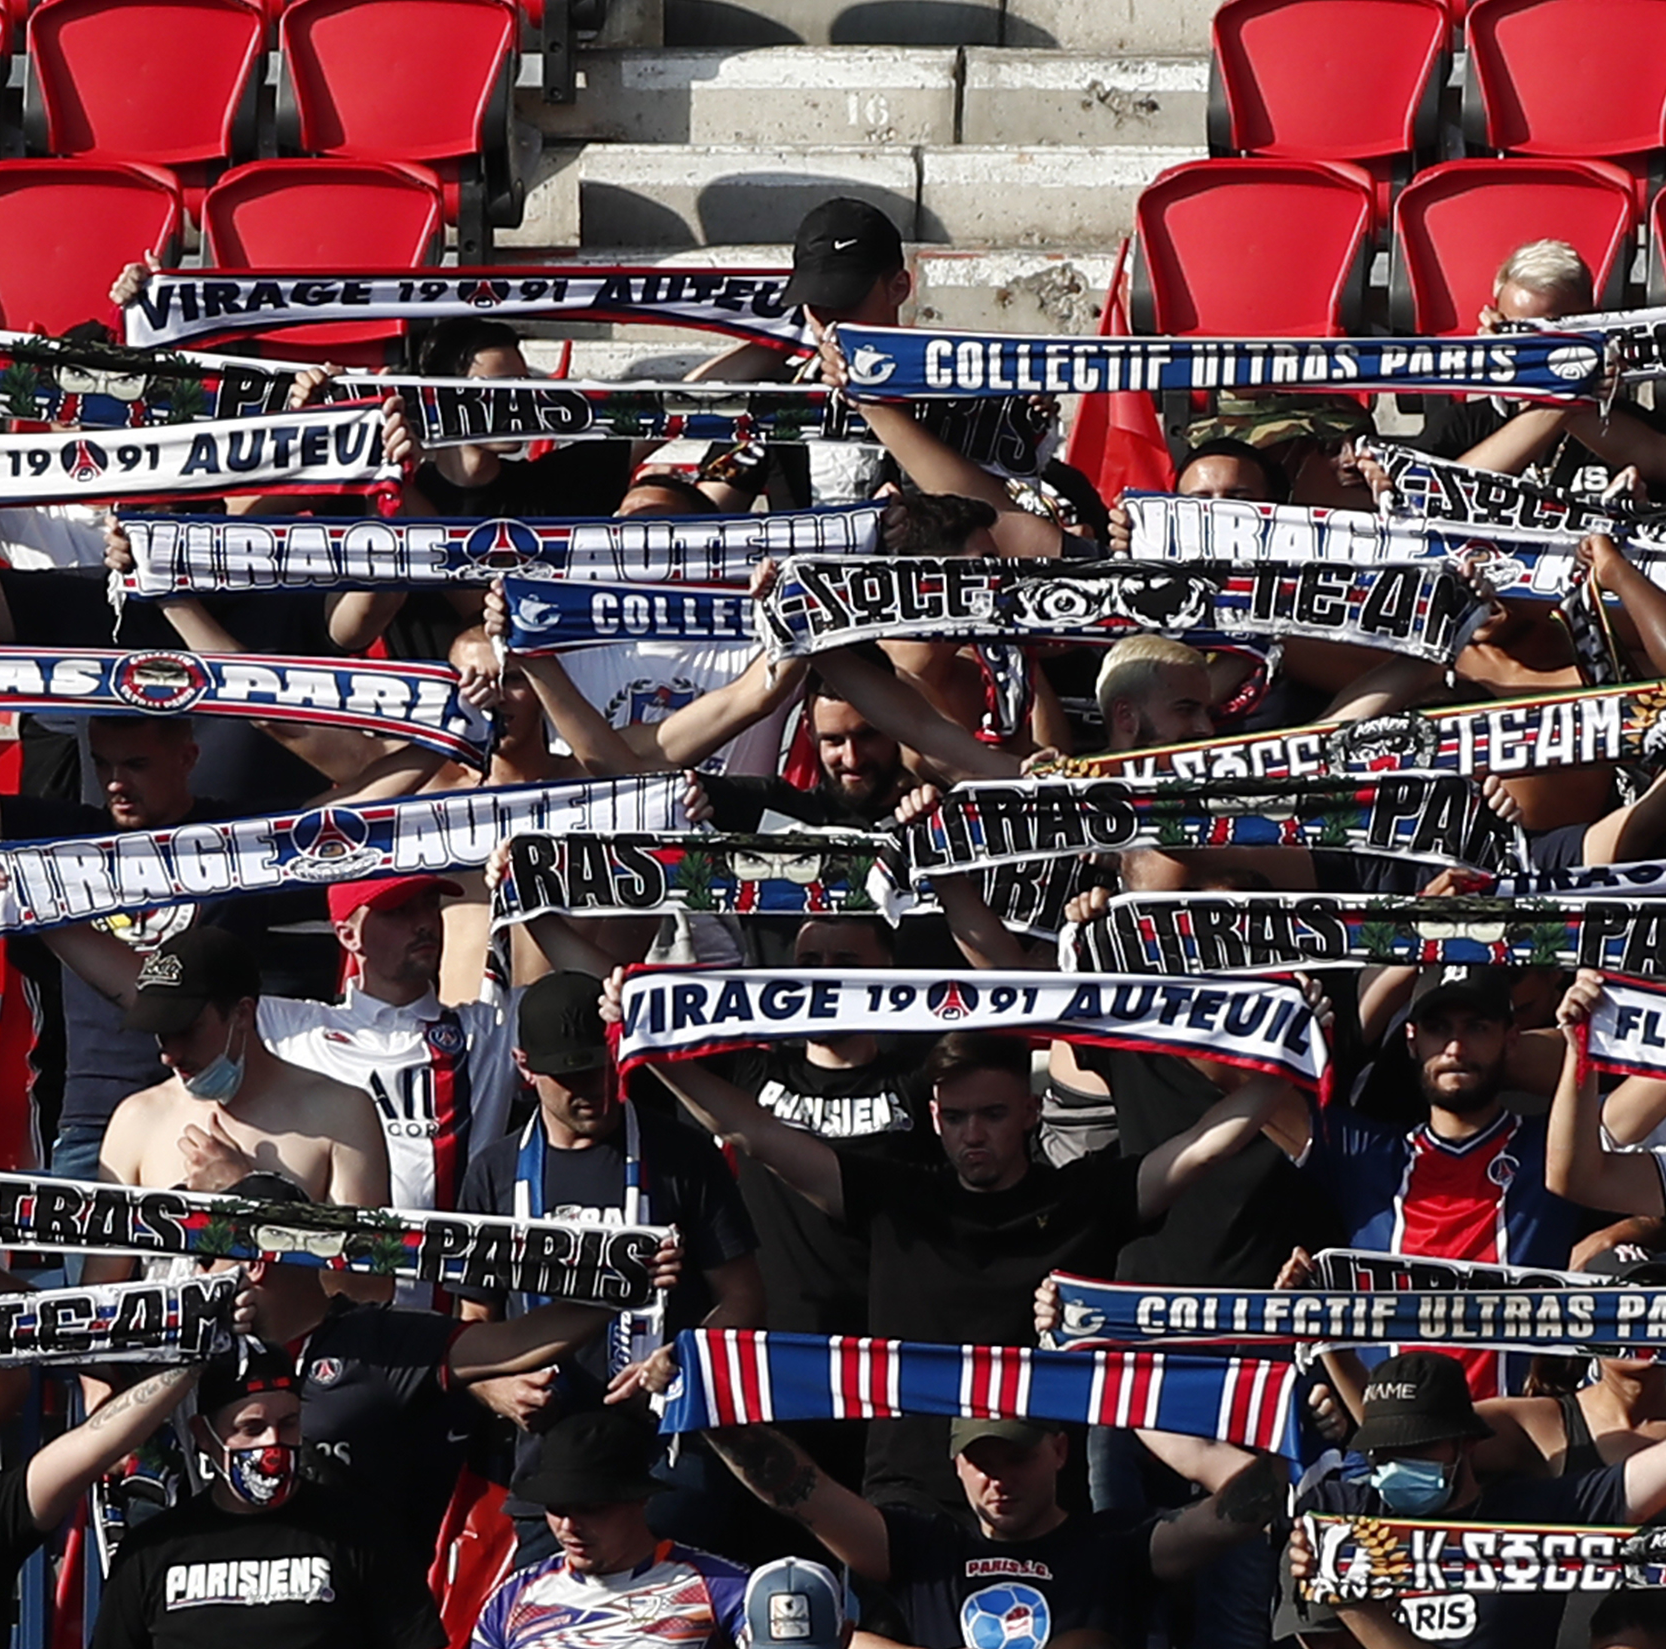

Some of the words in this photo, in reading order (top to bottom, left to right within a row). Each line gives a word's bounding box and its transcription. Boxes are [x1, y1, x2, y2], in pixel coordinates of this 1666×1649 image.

[846, 93, 889, 127] 16
[138, 278, 373, 331] VIRAGE
[399, 281, 446, 304] 19
[520, 281, 568, 303] 91
[591, 275, 805, 330] AUTEU
[924, 338, 1171, 393] COLLECTIF
[1190, 341, 1361, 389] ULTRAS
[1379, 343, 1518, 384] PARIS
[7, 448, 46, 478] 19
[117, 443, 159, 472] 91
[125, 521, 451, 593] VIRAGE
[1440, 695, 1623, 774] TEAM
[624, 980, 842, 1036] VIRAGE
[866, 985, 917, 1013] 19
[990, 985, 1035, 1015] 91
[1059, 982, 1312, 1056] AUTEUIL
[416, 1218, 664, 1308] PARIS
[1137, 1294, 1398, 1338] COLLECTIF
[1419, 1295, 1596, 1340] ULTRAS
[166, 1555, 331, 1602] PARISIENS
